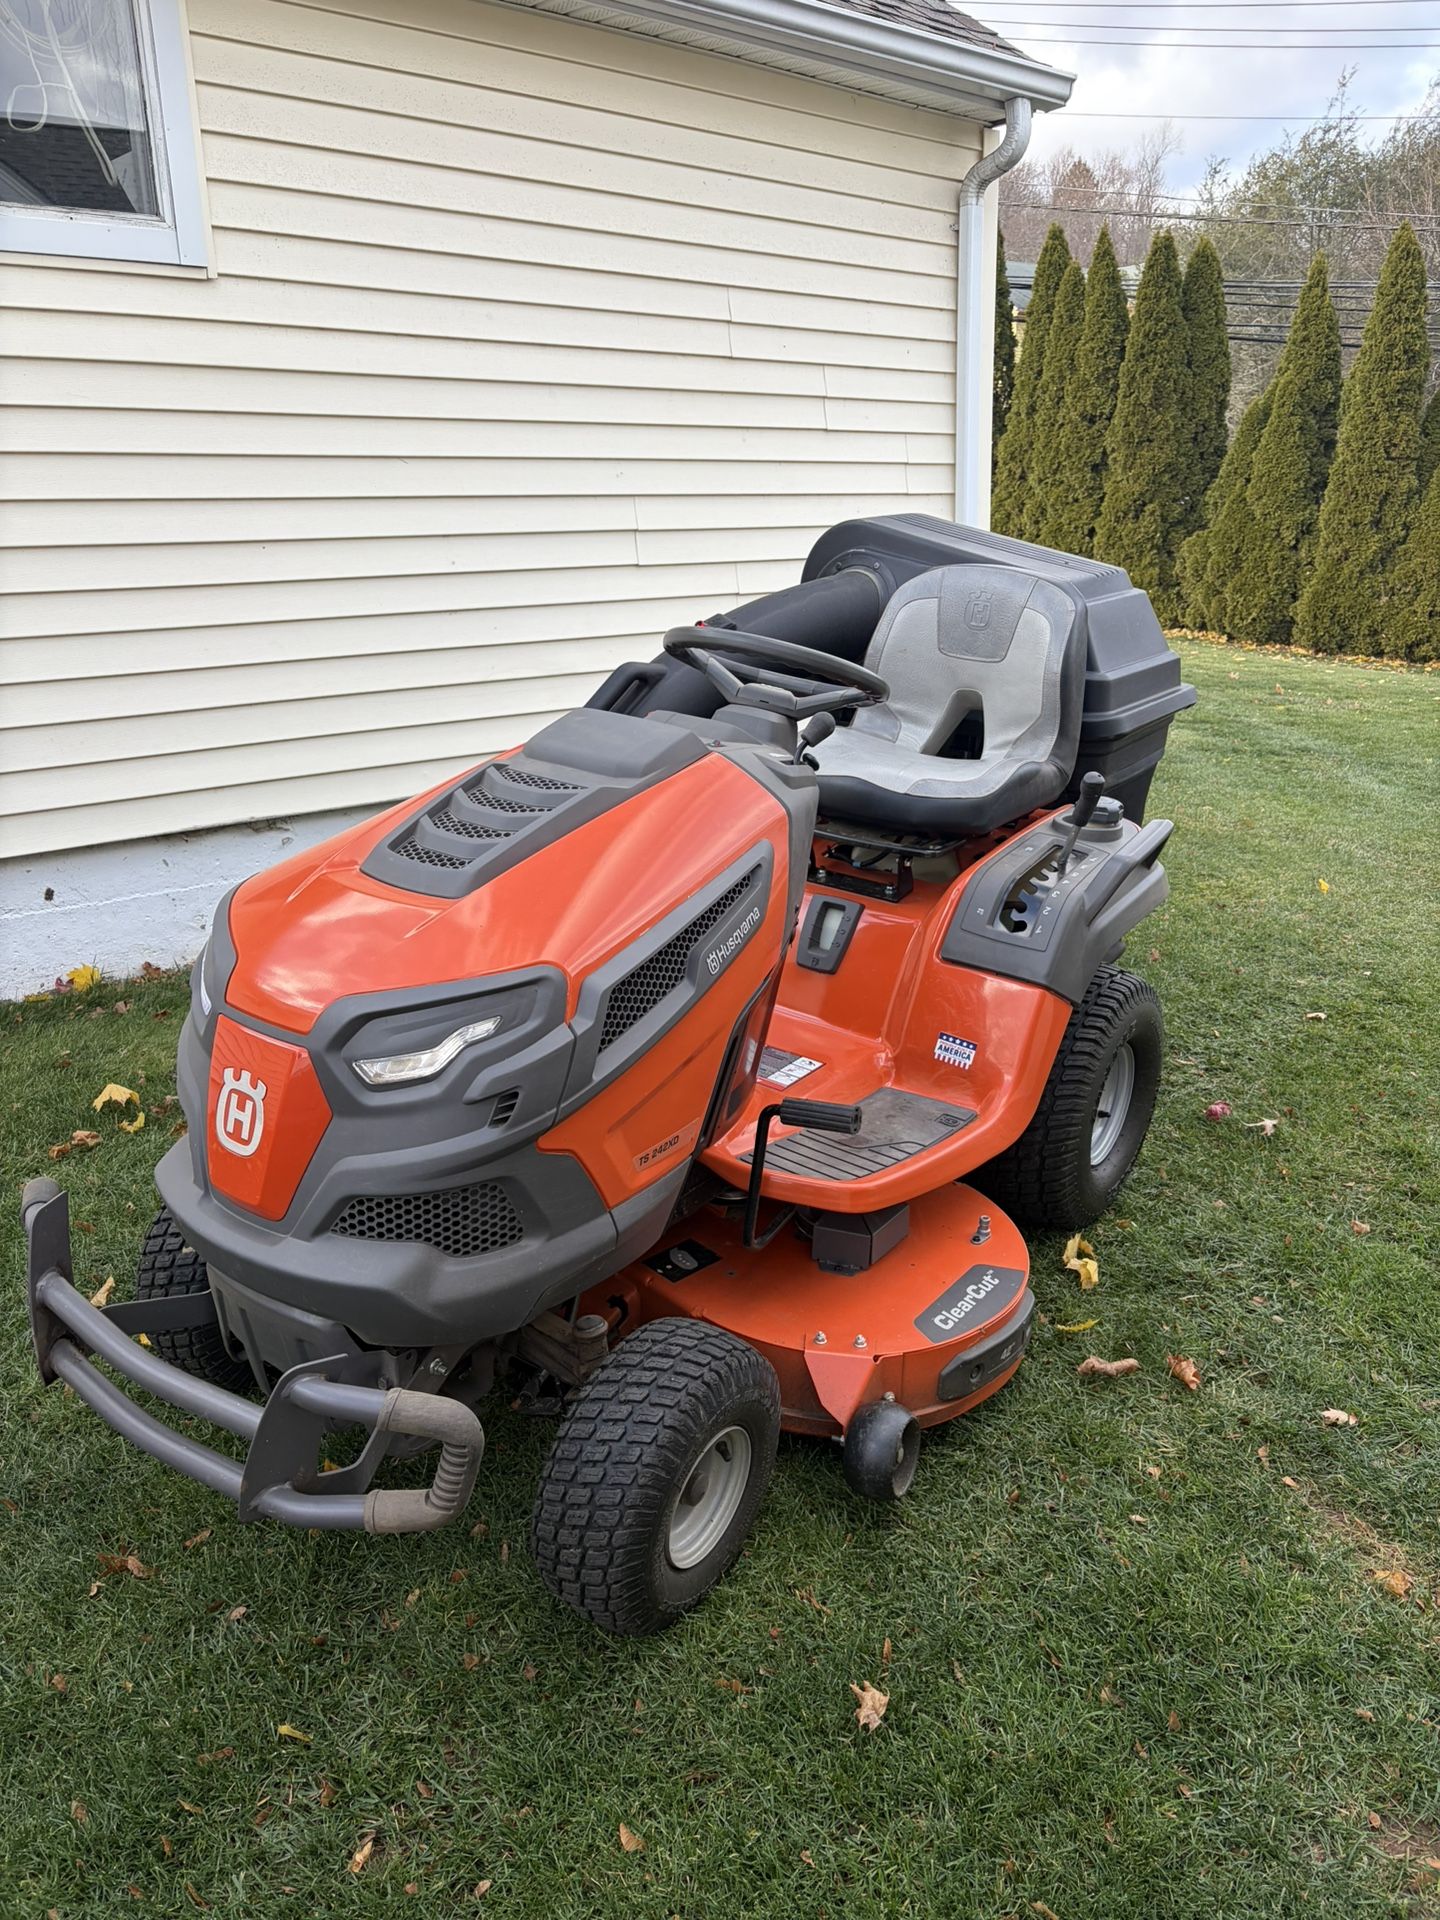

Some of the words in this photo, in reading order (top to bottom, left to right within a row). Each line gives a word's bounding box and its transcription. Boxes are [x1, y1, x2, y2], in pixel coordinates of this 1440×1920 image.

[717, 907, 760, 963] Husqvarna
[937, 1044, 971, 1061] AMERICA
[639, 1153, 649, 1166] TS
[652, 1135, 679, 1158] 242XD
